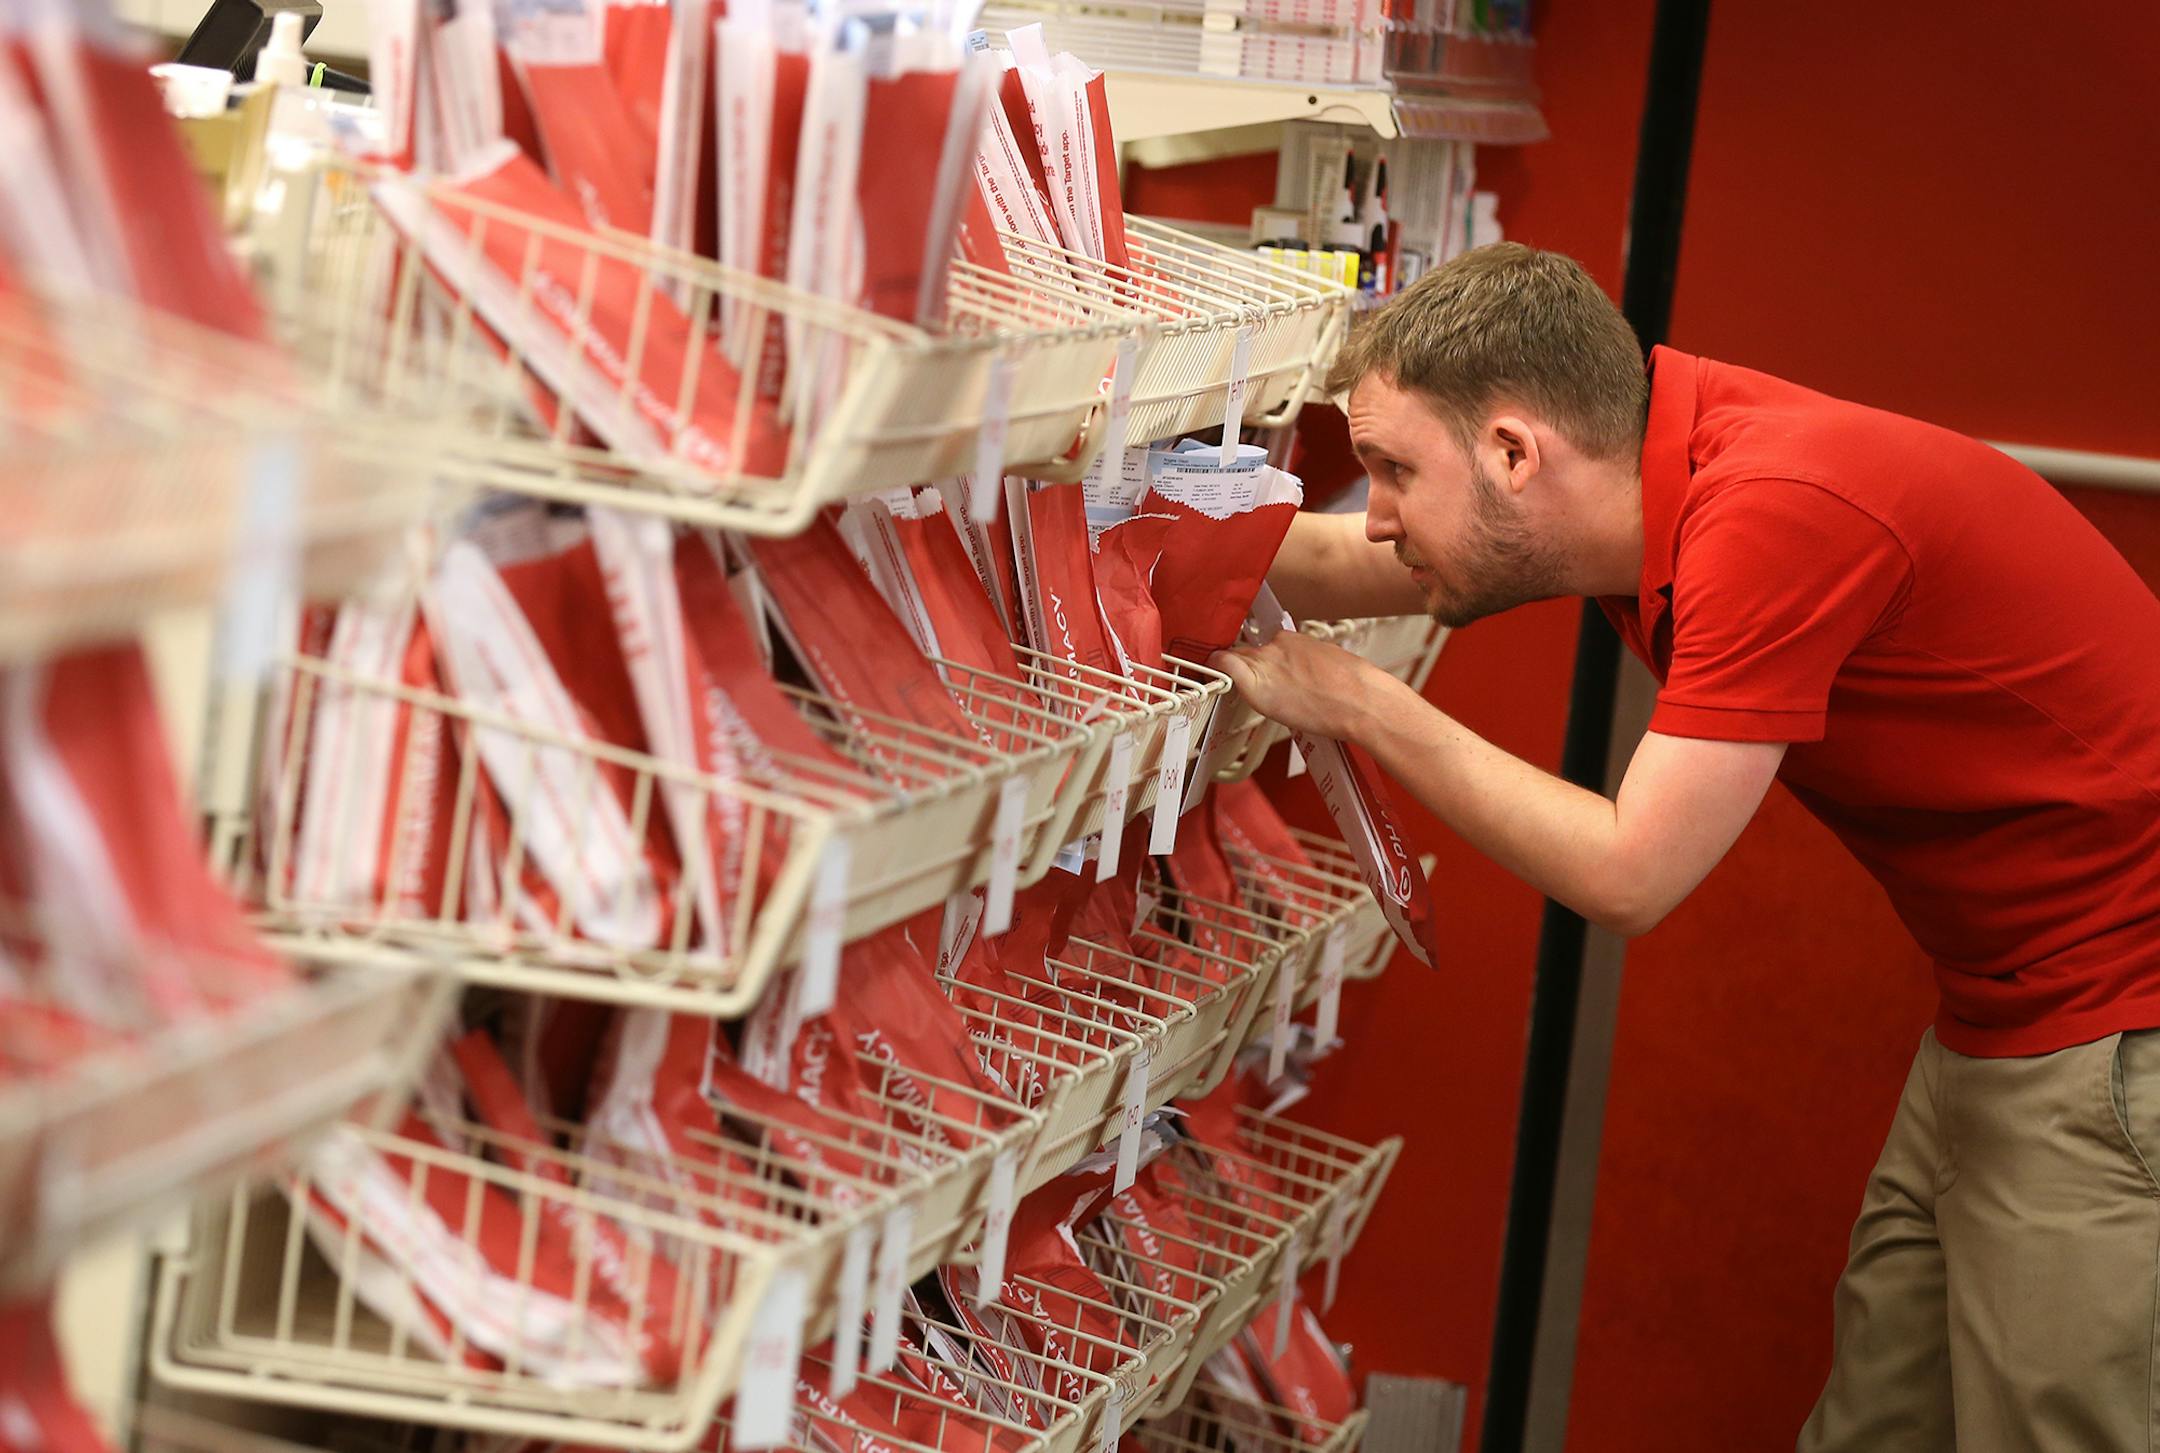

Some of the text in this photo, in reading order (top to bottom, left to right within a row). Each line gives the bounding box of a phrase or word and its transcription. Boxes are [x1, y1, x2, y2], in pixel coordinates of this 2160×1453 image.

[1063, 153, 1072, 185] Target
[987, 177, 998, 193] the
[995, 193, 1009, 214] with
[965, 525, 979, 558] Target
[1021, 556, 1031, 586] Target
